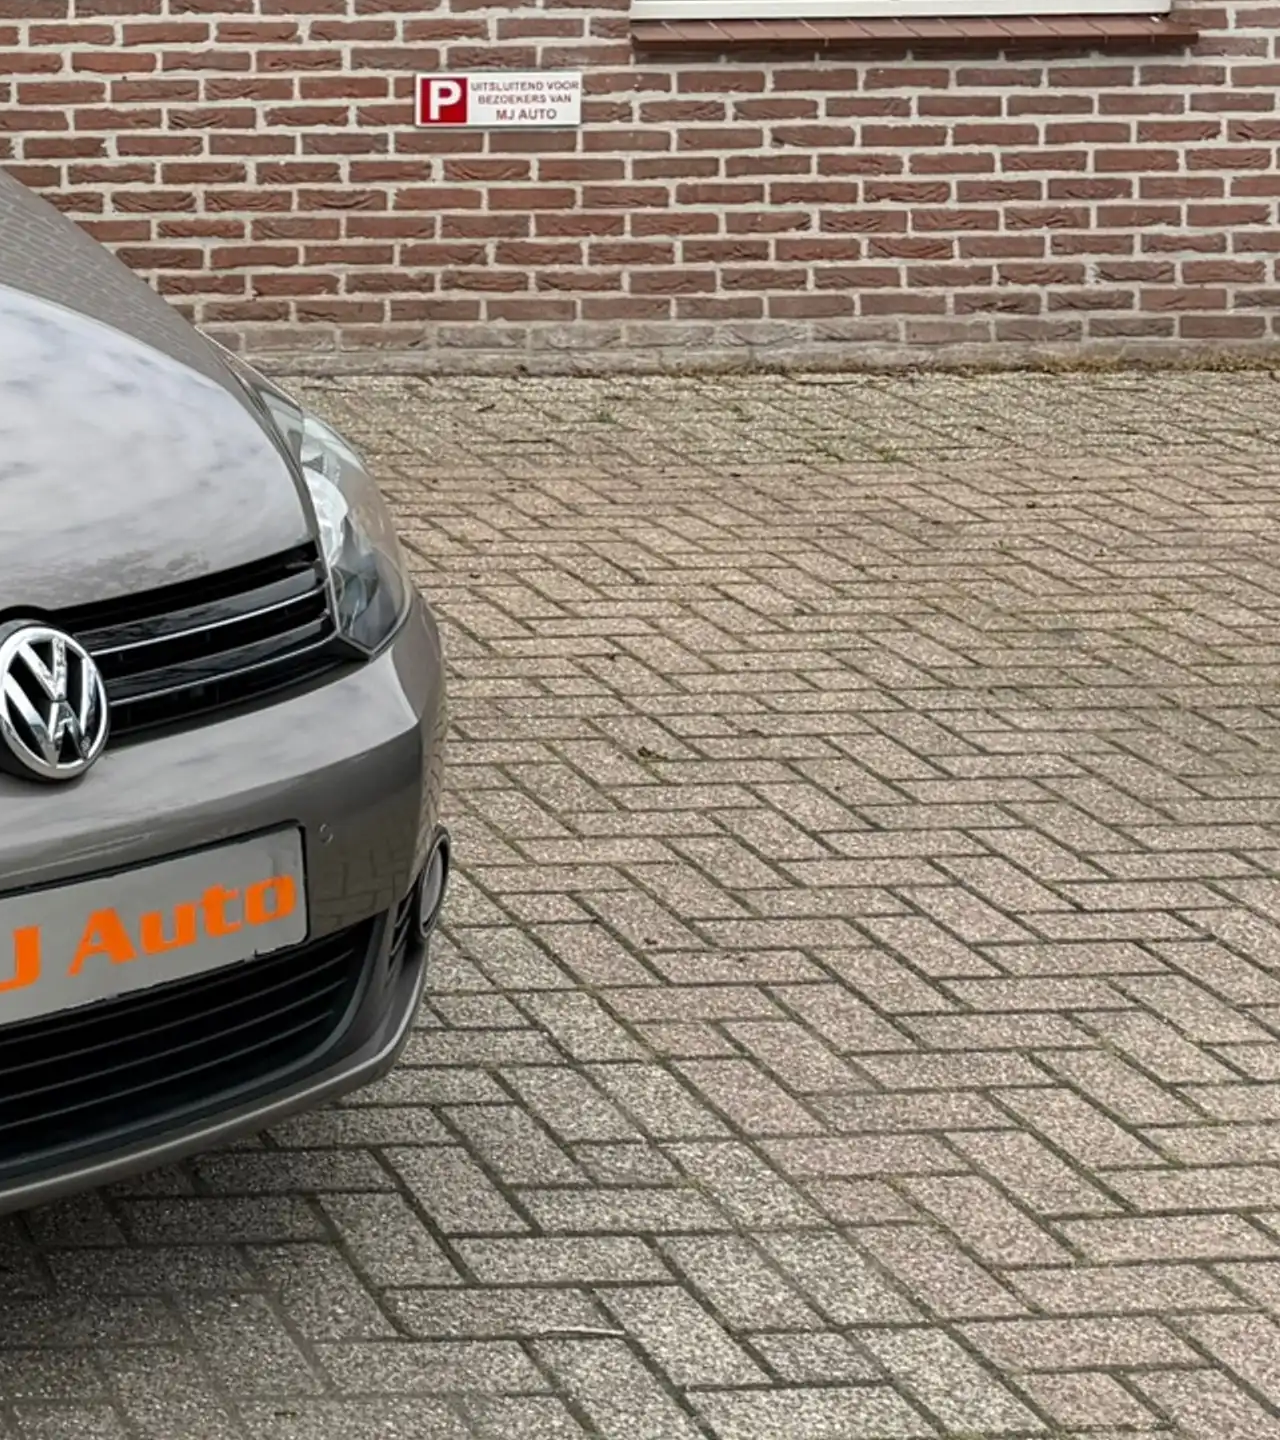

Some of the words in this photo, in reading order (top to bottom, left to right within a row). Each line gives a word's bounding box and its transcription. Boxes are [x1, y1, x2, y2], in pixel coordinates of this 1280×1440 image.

[471, 81, 544, 92] UITSLUITEND
[547, 80, 579, 91] VOOR
[429, 80, 461, 121] P
[478, 94, 547, 105] BEZOEKERS
[549, 94, 572, 104] VAN
[496, 109, 515, 120] MJ
[518, 108, 557, 120] AUTO
[68, 873, 297, 977] Auto
